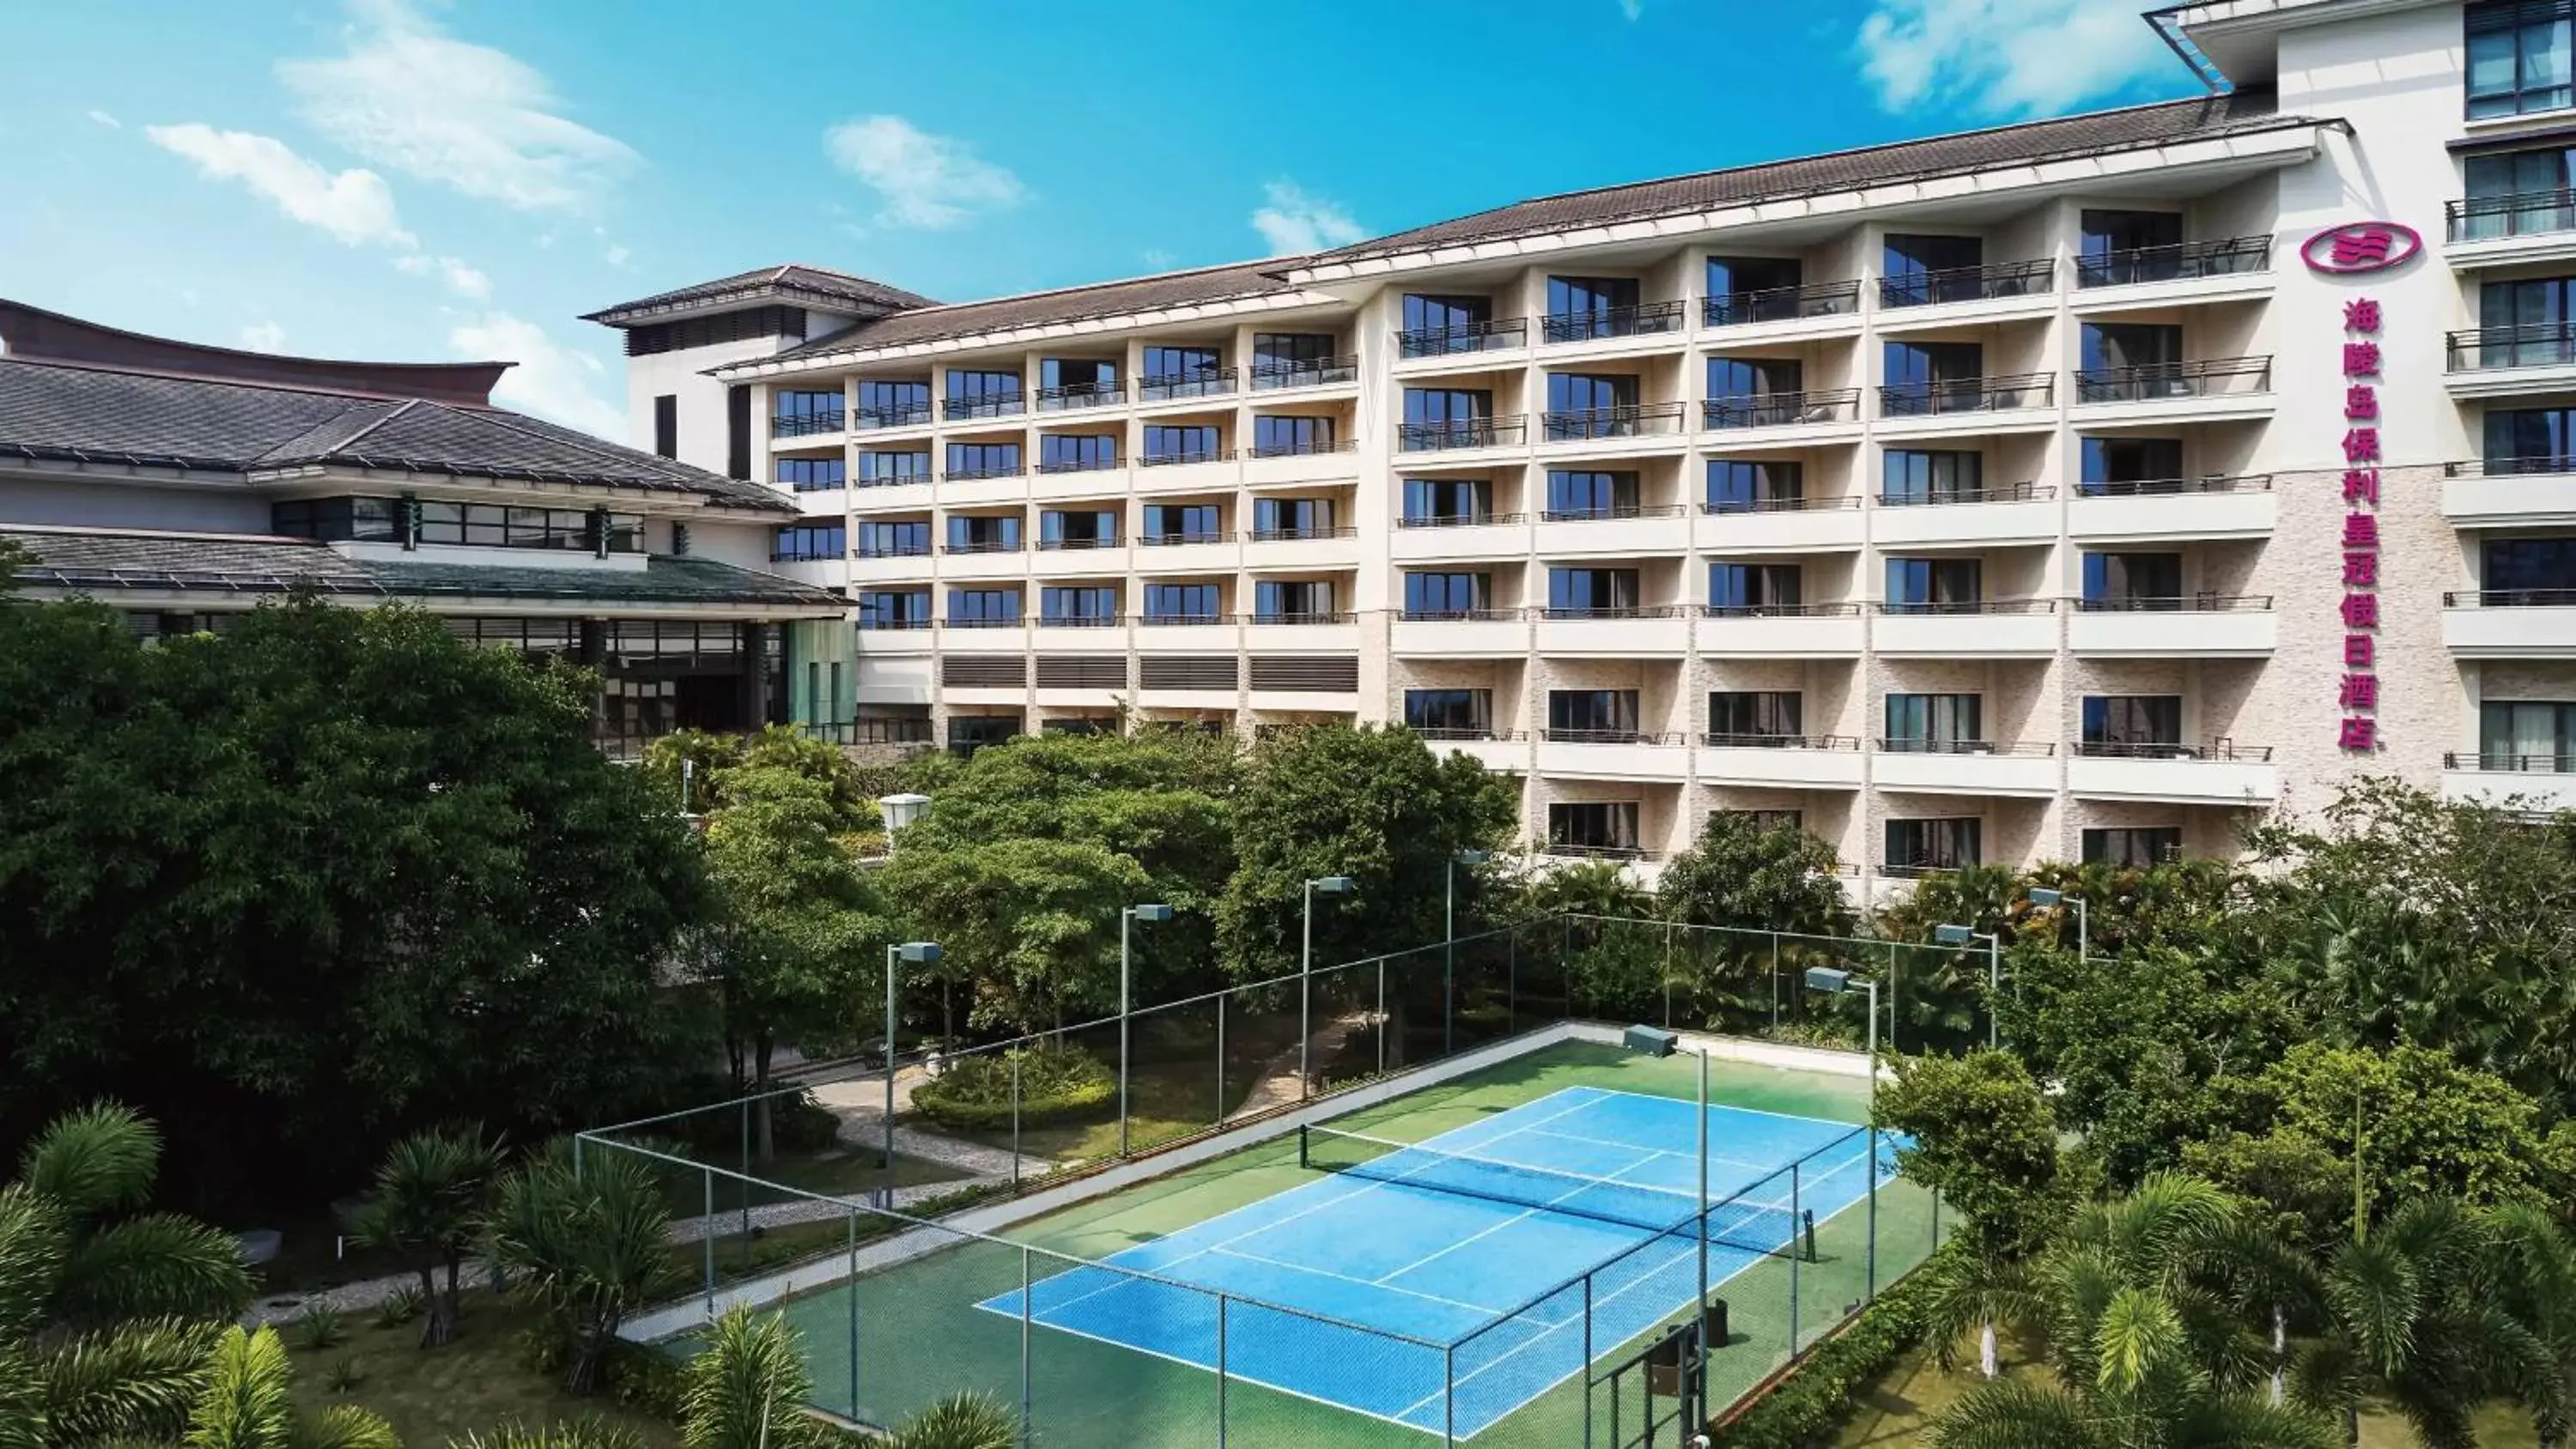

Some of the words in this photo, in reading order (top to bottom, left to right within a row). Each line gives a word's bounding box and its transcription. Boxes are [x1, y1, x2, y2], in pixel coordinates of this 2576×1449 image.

[2339, 298, 2379, 750] 海陵岛保利皇冠假日酒店
